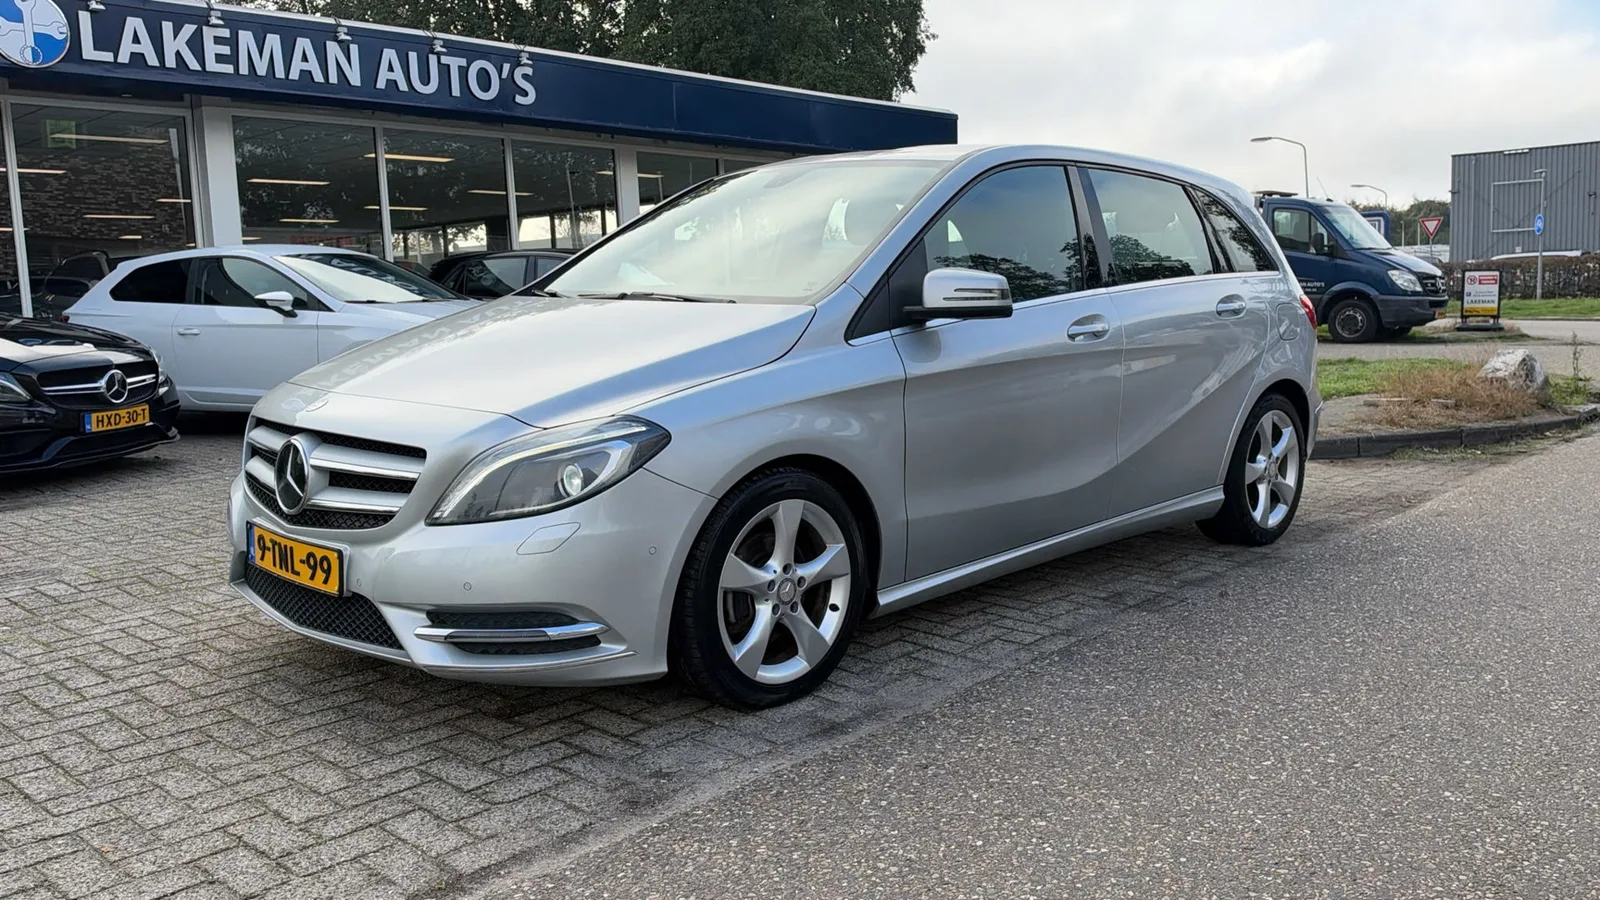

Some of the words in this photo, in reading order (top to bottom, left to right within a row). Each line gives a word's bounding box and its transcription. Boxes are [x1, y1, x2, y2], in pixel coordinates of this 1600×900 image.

[78, 10, 361, 87] LAKEMAN
[376, 48, 537, 105] AUTO'S
[96, 408, 147, 428] HXD-30-T
[257, 533, 332, 585] 9-TNL-99
